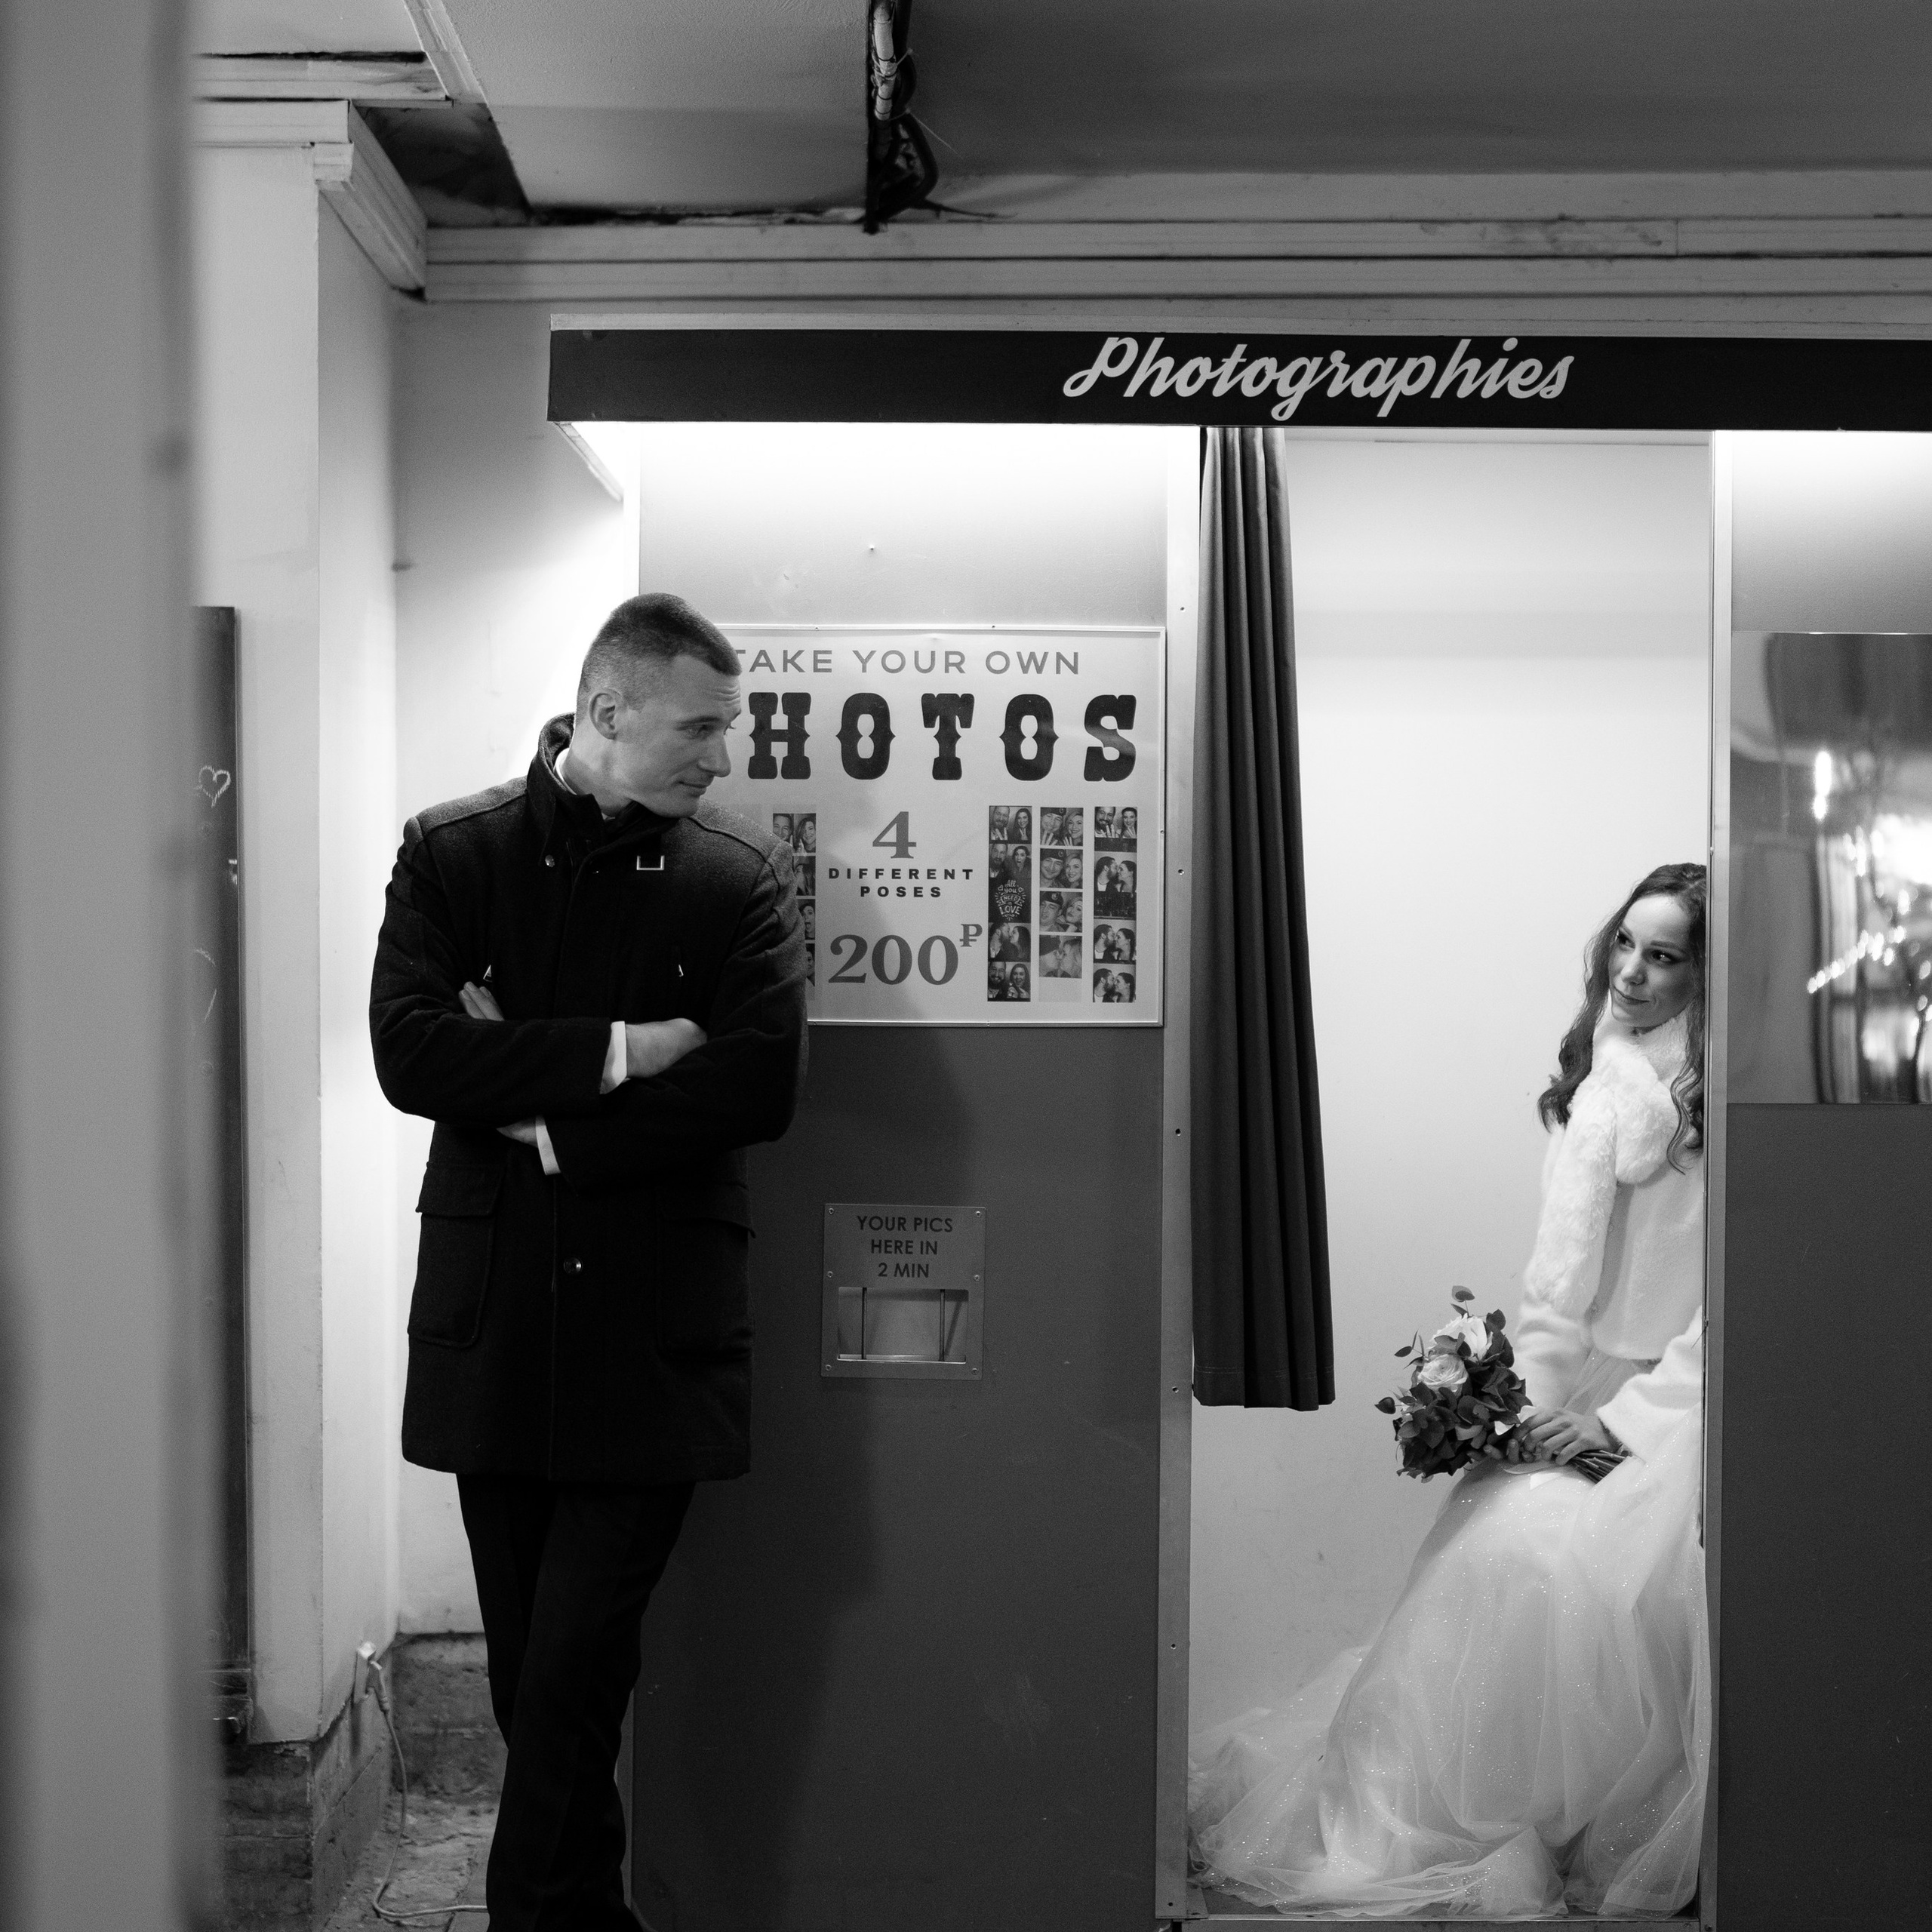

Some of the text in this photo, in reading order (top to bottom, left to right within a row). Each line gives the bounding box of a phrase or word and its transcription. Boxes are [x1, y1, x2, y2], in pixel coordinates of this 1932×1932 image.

[1063, 337, 1575, 421] Photographies
[852, 650, 966, 674] YOUR
[985, 651, 1079, 675] OWN
[747, 691, 1137, 782] HOTOS
[872, 811, 917, 859] 4
[828, 867, 974, 880] DIFFERENT
[860, 885, 941, 898] POSES
[999, 905, 1022, 915] LOVE
[857, 1215, 953, 1233] YOUR PICS
[870, 1238, 938, 1256] HERE IN
[877, 1262, 930, 1278] 2 MIN
